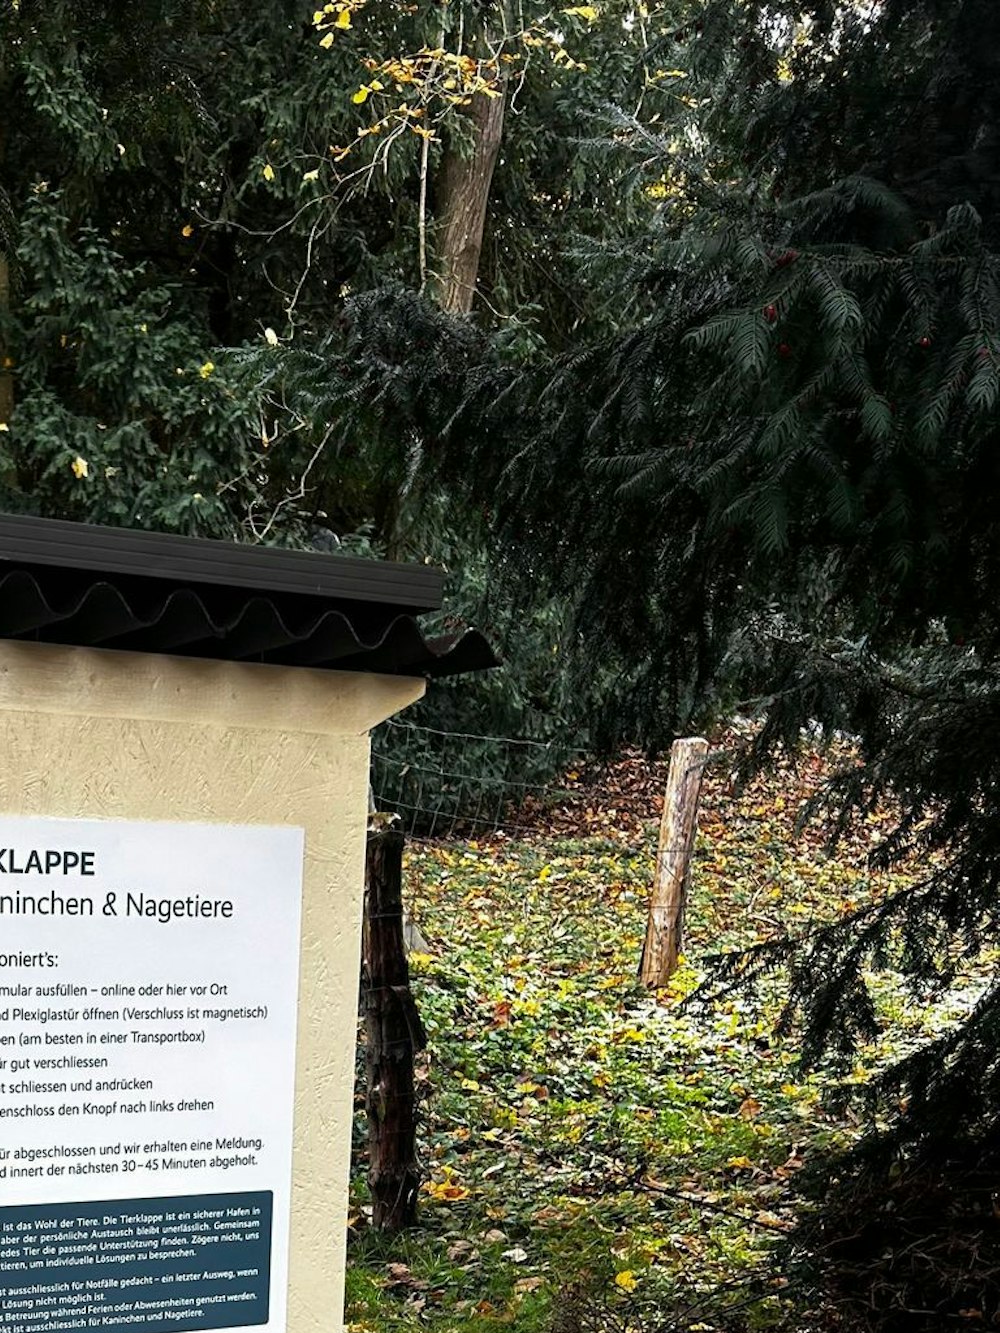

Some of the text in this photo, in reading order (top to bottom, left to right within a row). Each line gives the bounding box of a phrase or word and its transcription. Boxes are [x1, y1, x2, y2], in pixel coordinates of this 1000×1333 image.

[102, 891, 118, 916] &
[126, 892, 233, 923] Nagetiere
[35, 983, 88, 997] ausfüllen
[100, 983, 136, 996] online
[138, 983, 164, 996] oder
[166, 983, 188, 996] hier
[189, 986, 208, 996] vor
[209, 982, 228, 996] Ort
[12, 1008, 80, 1024] Plexiglastür
[82, 1007, 119, 1021] öffnen
[122, 1007, 184, 1021] (Verschluss
[186, 1007, 200, 1019] ist
[202, 1005, 268, 1022] magnetisch)
[18, 1032, 42, 1047] (am
[44, 1032, 83, 1045] besten
[86, 1032, 97, 1044] in
[99, 1032, 128, 1044] einer
[130, 1030, 205, 1045] Transportbox)
[10, 1058, 30, 1073] gut
[33, 1055, 108, 1069] verschliessen
[8, 1080, 67, 1094] schliessen
[70, 1079, 93, 1092] und
[95, 1077, 153, 1091] andrücken
[58, 1103, 79, 1116] den
[83, 1101, 117, 1117] Knopf
[120, 1100, 146, 1114] nach
[150, 1099, 174, 1112] links
[177, 1098, 214, 1111] drehen
[13, 1145, 96, 1162] abgeschlossen
[99, 1142, 121, 1156] und
[123, 1144, 141, 1154] wir
[143, 1140, 187, 1154] erhalten
[190, 1141, 213, 1151] eine
[215, 1137, 265, 1151] Meldung.
[10, 1166, 44, 1178] innert
[46, 1163, 65, 1176] der
[68, 1162, 119, 1175] nächsten
[161, 1158, 207, 1170] Minuten
[209, 1154, 258, 1170] abgeholt.
[2, 1222, 14, 1232] ist
[16, 1221, 32, 1231] das
[34, 1219, 58, 1230] Wohl
[59, 1218, 75, 1228] der
[76, 1217, 100, 1227] Tiere.
[102, 1215, 118, 1226] Die
[119, 1213, 163, 1224] Tierklappe
[165, 1212, 176, 1221] ist
[177, 1211, 191, 1220] ein
[192, 1209, 225, 1219] sicherer
[0, 1220, 260, 1245] aber der persönliche Gemeinsam
[22, 1246, 41, 1256] Tier
[41, 1245, 56, 1255] die
[58, 1242, 98, 1255] passende
[29, 1260, 44, 1269] um
[95, 1253, 136, 1264] Lösungen
[136, 1253, 148, 1261] zu
[148, 1248, 197, 1260] besprechen.
[8, 1282, 70, 1296] ausschliesslich
[71, 1281, 84, 1291] für
[85, 1278, 119, 1289] Notfälle
[120, 1276, 153, 1289] gedacht
[161, 1274, 174, 1283] ein
[2, 1299, 34, 1309] Lösung
[35, 1296, 57, 1306] nicht
[58, 1293, 93, 1305] möglich
[94, 1292, 107, 1301] ist.
[4, 1311, 50, 1322] Betreuung
[50, 1305, 87, 1317] während
[87, 1304, 114, 1314] Ferien
[113, 1302, 133, 1312] oder
[133, 1297, 195, 1310] Abwesenheiten
[13, 1324, 24, 1333] ist
[25, 1318, 87, 1332] ausschliesslich
[88, 1317, 101, 1327] für
[101, 1314, 145, 1325] Kaninchen
[146, 1311, 163, 1321] und
[164, 1308, 205, 1321] Nagetiere.
